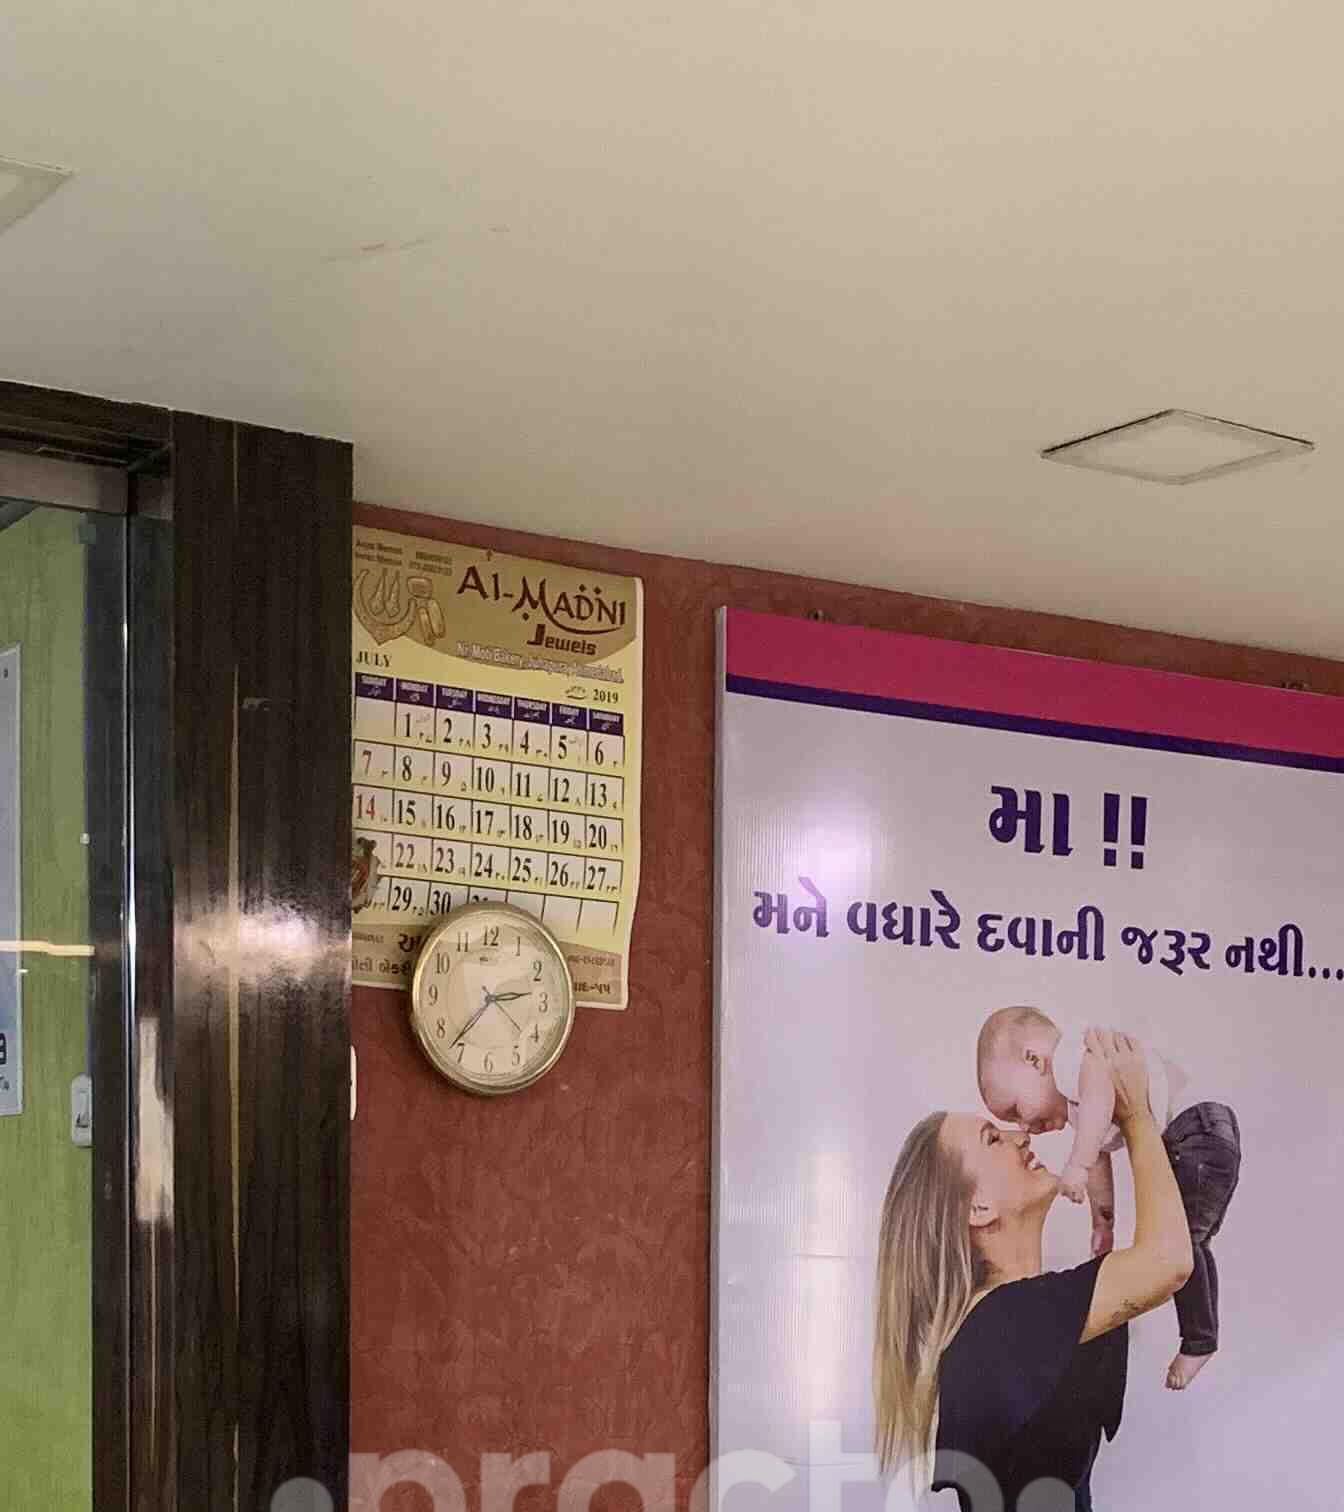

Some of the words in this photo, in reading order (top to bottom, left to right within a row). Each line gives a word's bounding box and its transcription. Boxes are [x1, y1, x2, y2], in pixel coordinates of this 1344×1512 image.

[527, 623, 597, 655] Jewels
[356, 650, 392, 668] JULY
[593, 688, 619, 704] 2019
[403, 713, 411, 738] 1
[443, 718, 452, 743] 2
[482, 723, 491, 749] 3
[519, 730, 529, 755] 4
[558, 735, 568, 760] 5
[594, 741, 604, 765] 6
[362, 750, 372, 774] 7
[402, 755, 412, 781] 8
[441, 761, 451, 786] 9
[476, 767, 494, 793] 10
[515, 773, 531, 798] 11
[554, 778, 570, 803] 12
[590, 783, 607, 808] 13
[356, 795, 375, 820] 14
[397, 800, 416, 825] 15
[436, 804, 455, 830] 16
[474, 811, 494, 835] 17
[514, 815, 532, 840] 18
[552, 820, 570, 844] 19
[588, 824, 607, 849] 20
[989, 785, 1073, 857] મા
[395, 843, 414, 869] 22
[435, 848, 454, 873] 23
[474, 853, 493, 878] 24
[512, 858, 531, 883] 25
[550, 862, 568, 887] 26
[587, 867, 606, 891] 27
[392, 886, 411, 912] 29
[430, 891, 451, 916] 30
[483, 926, 499, 947] 12
[753, 877, 829, 938] મને
[847, 890, 960, 949] વધારે
[977, 906, 1105, 961] દવાની
[1121, 926, 1211, 975] જરૂર
[457, 932, 470, 953] 11
[436, 953, 450, 974] 10
[533, 961, 542, 981] 2
[428, 985, 438, 1005] 9
[539, 992, 548, 1012] 3
[436, 1019, 446, 1039] 8
[530, 1024, 540, 1043] 4
[484, 1053, 493, 1072] 6
[511, 1045, 521, 1065] 5
